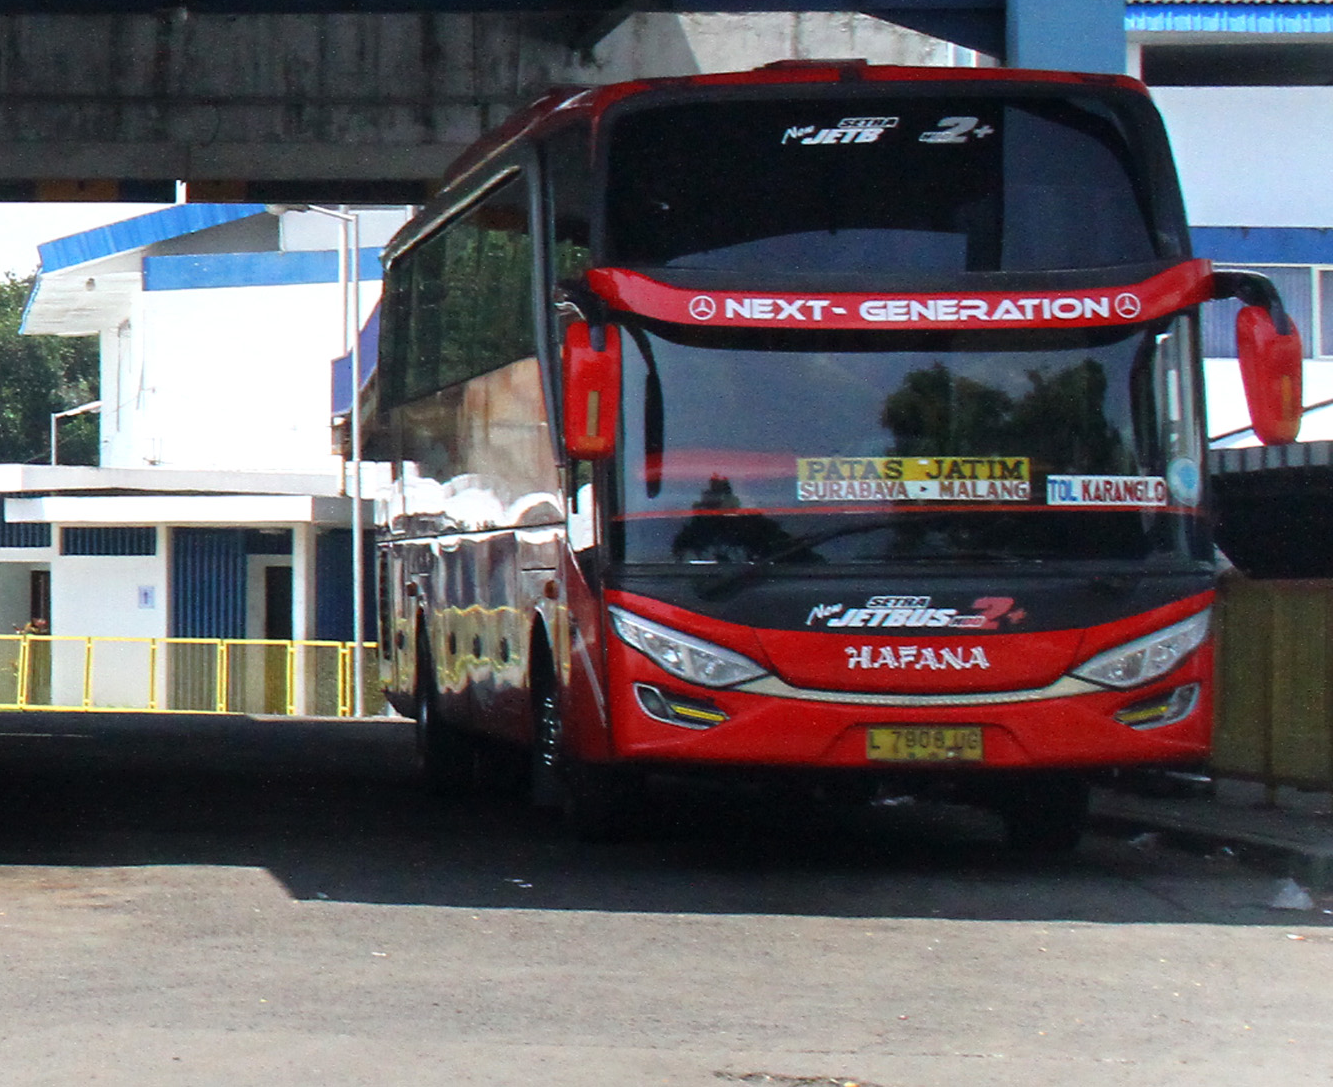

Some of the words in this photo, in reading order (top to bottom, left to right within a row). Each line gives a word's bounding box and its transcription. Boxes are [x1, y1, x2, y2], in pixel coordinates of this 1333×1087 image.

[859, 297, 1109, 322] GENERATION
[807, 459, 903, 480] PATAS
[926, 459, 1024, 479] JATIM
[800, 481, 910, 499] SURABAYA
[938, 480, 1030, 499] MALANG
[1048, 479, 1079, 502] TOL
[1082, 480, 1167, 502] KARANGLO
[827, 608, 958, 627] JETBUS
[844, 646, 991, 670] HAFANA
